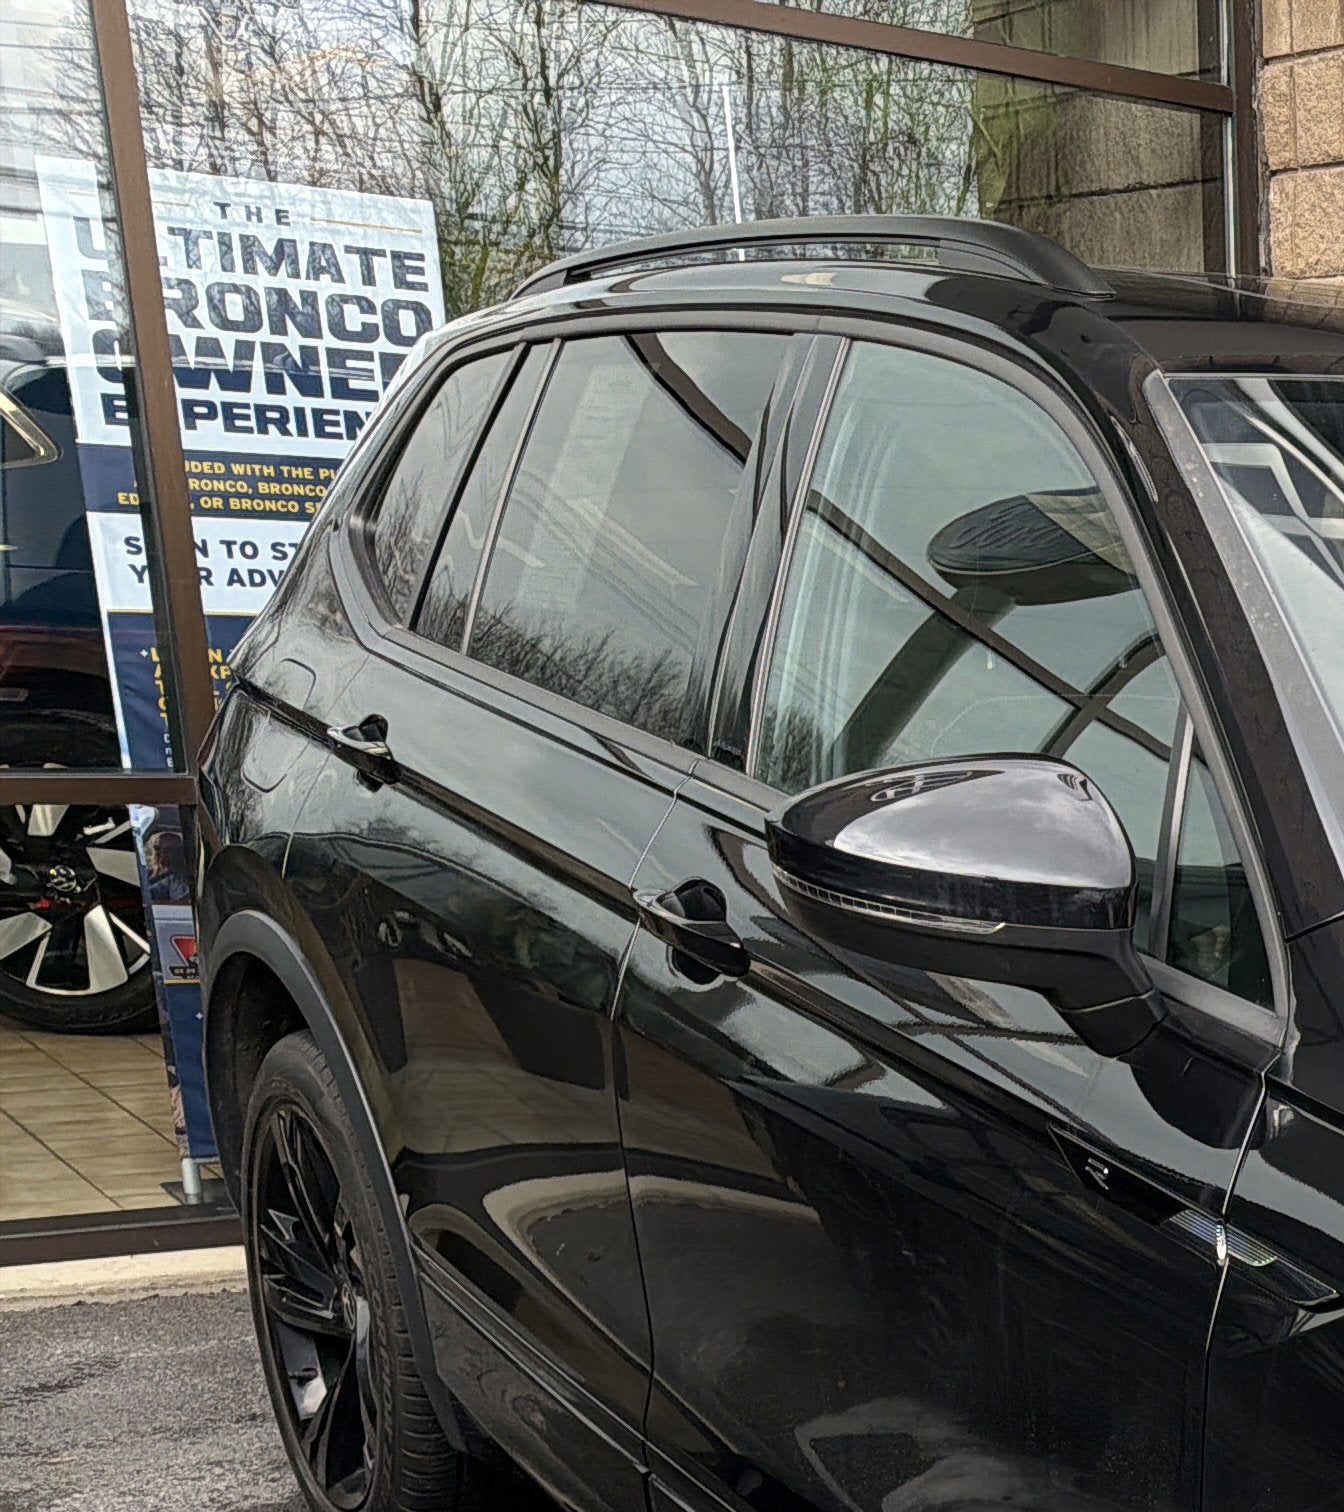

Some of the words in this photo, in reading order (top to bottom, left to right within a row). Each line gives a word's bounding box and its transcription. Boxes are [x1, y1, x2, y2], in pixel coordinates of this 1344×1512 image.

[213, 202, 291, 227] THE
[230, 462, 276, 477] WITH
[280, 465, 314, 480] THE
[200, 496, 224, 509] OR
[229, 498, 299, 513] BRONCO
[219, 539, 259, 560] TO
